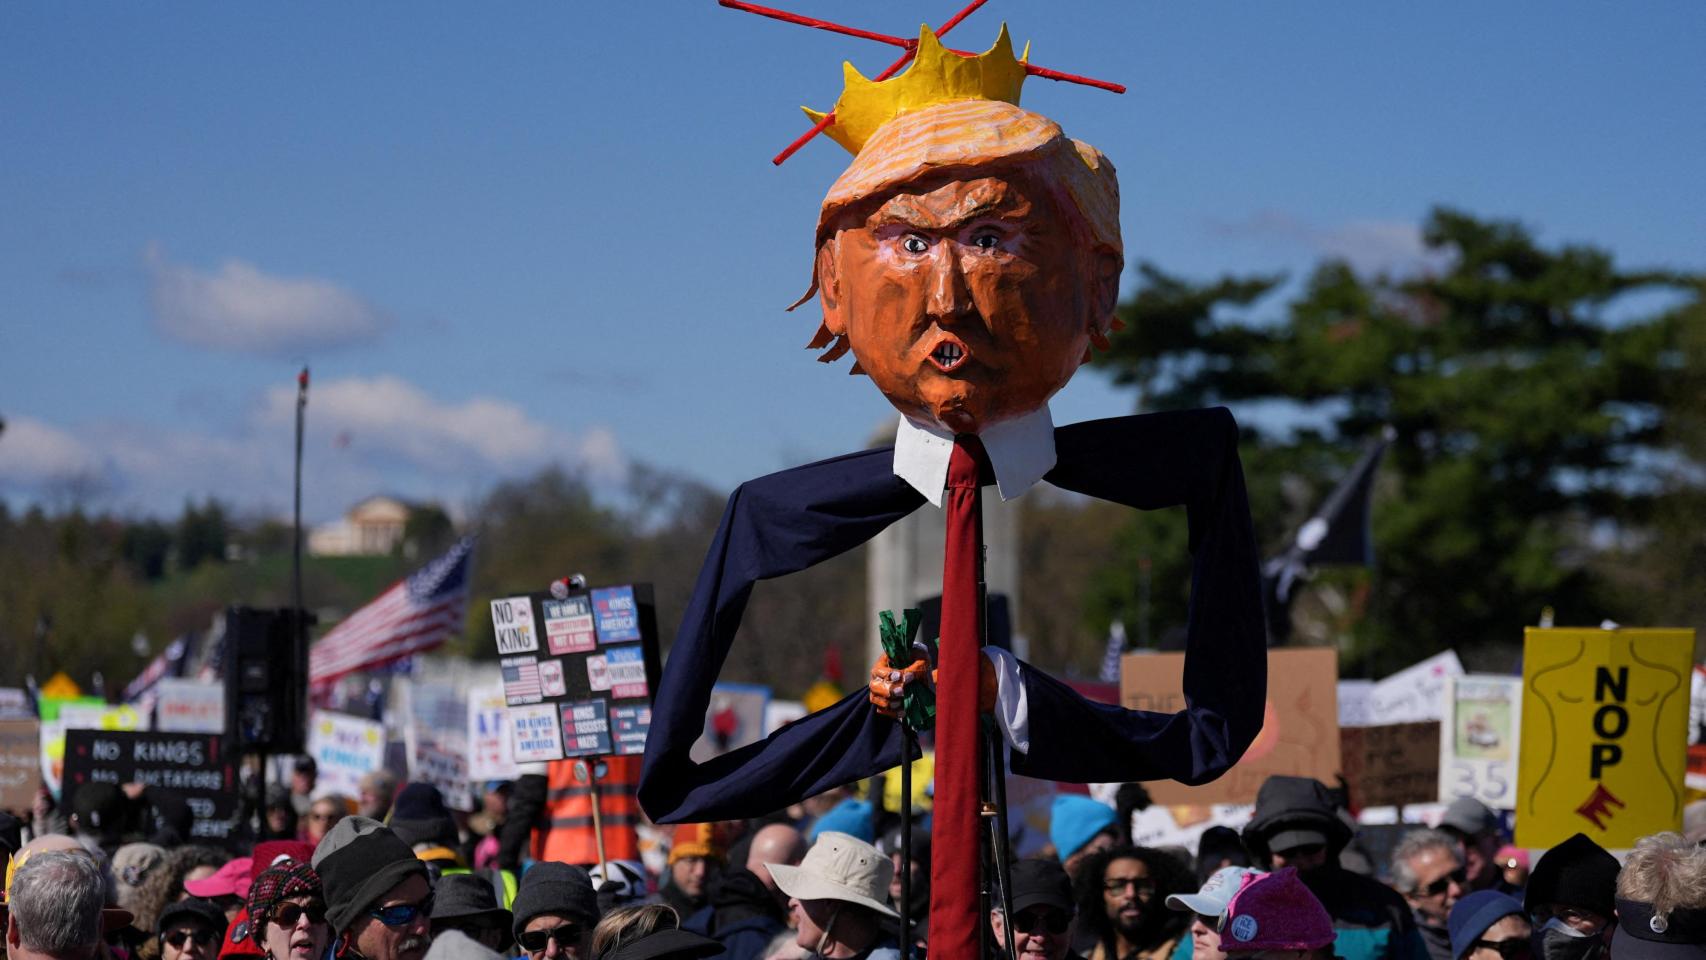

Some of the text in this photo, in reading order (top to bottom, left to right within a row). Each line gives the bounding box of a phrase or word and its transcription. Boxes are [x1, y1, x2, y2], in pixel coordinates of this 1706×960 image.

[494, 602, 514, 625] NO
[601, 616, 633, 632] AMERICA
[515, 719, 527, 730] NO
[528, 716, 552, 729] KINGS
[92, 740, 121, 761] NO
[520, 739, 554, 751] AMERICA
[1574, 666, 1630, 832] NOPE
[1240, 916, 1253, 929] ICE
[1234, 927, 1251, 940] OUT
